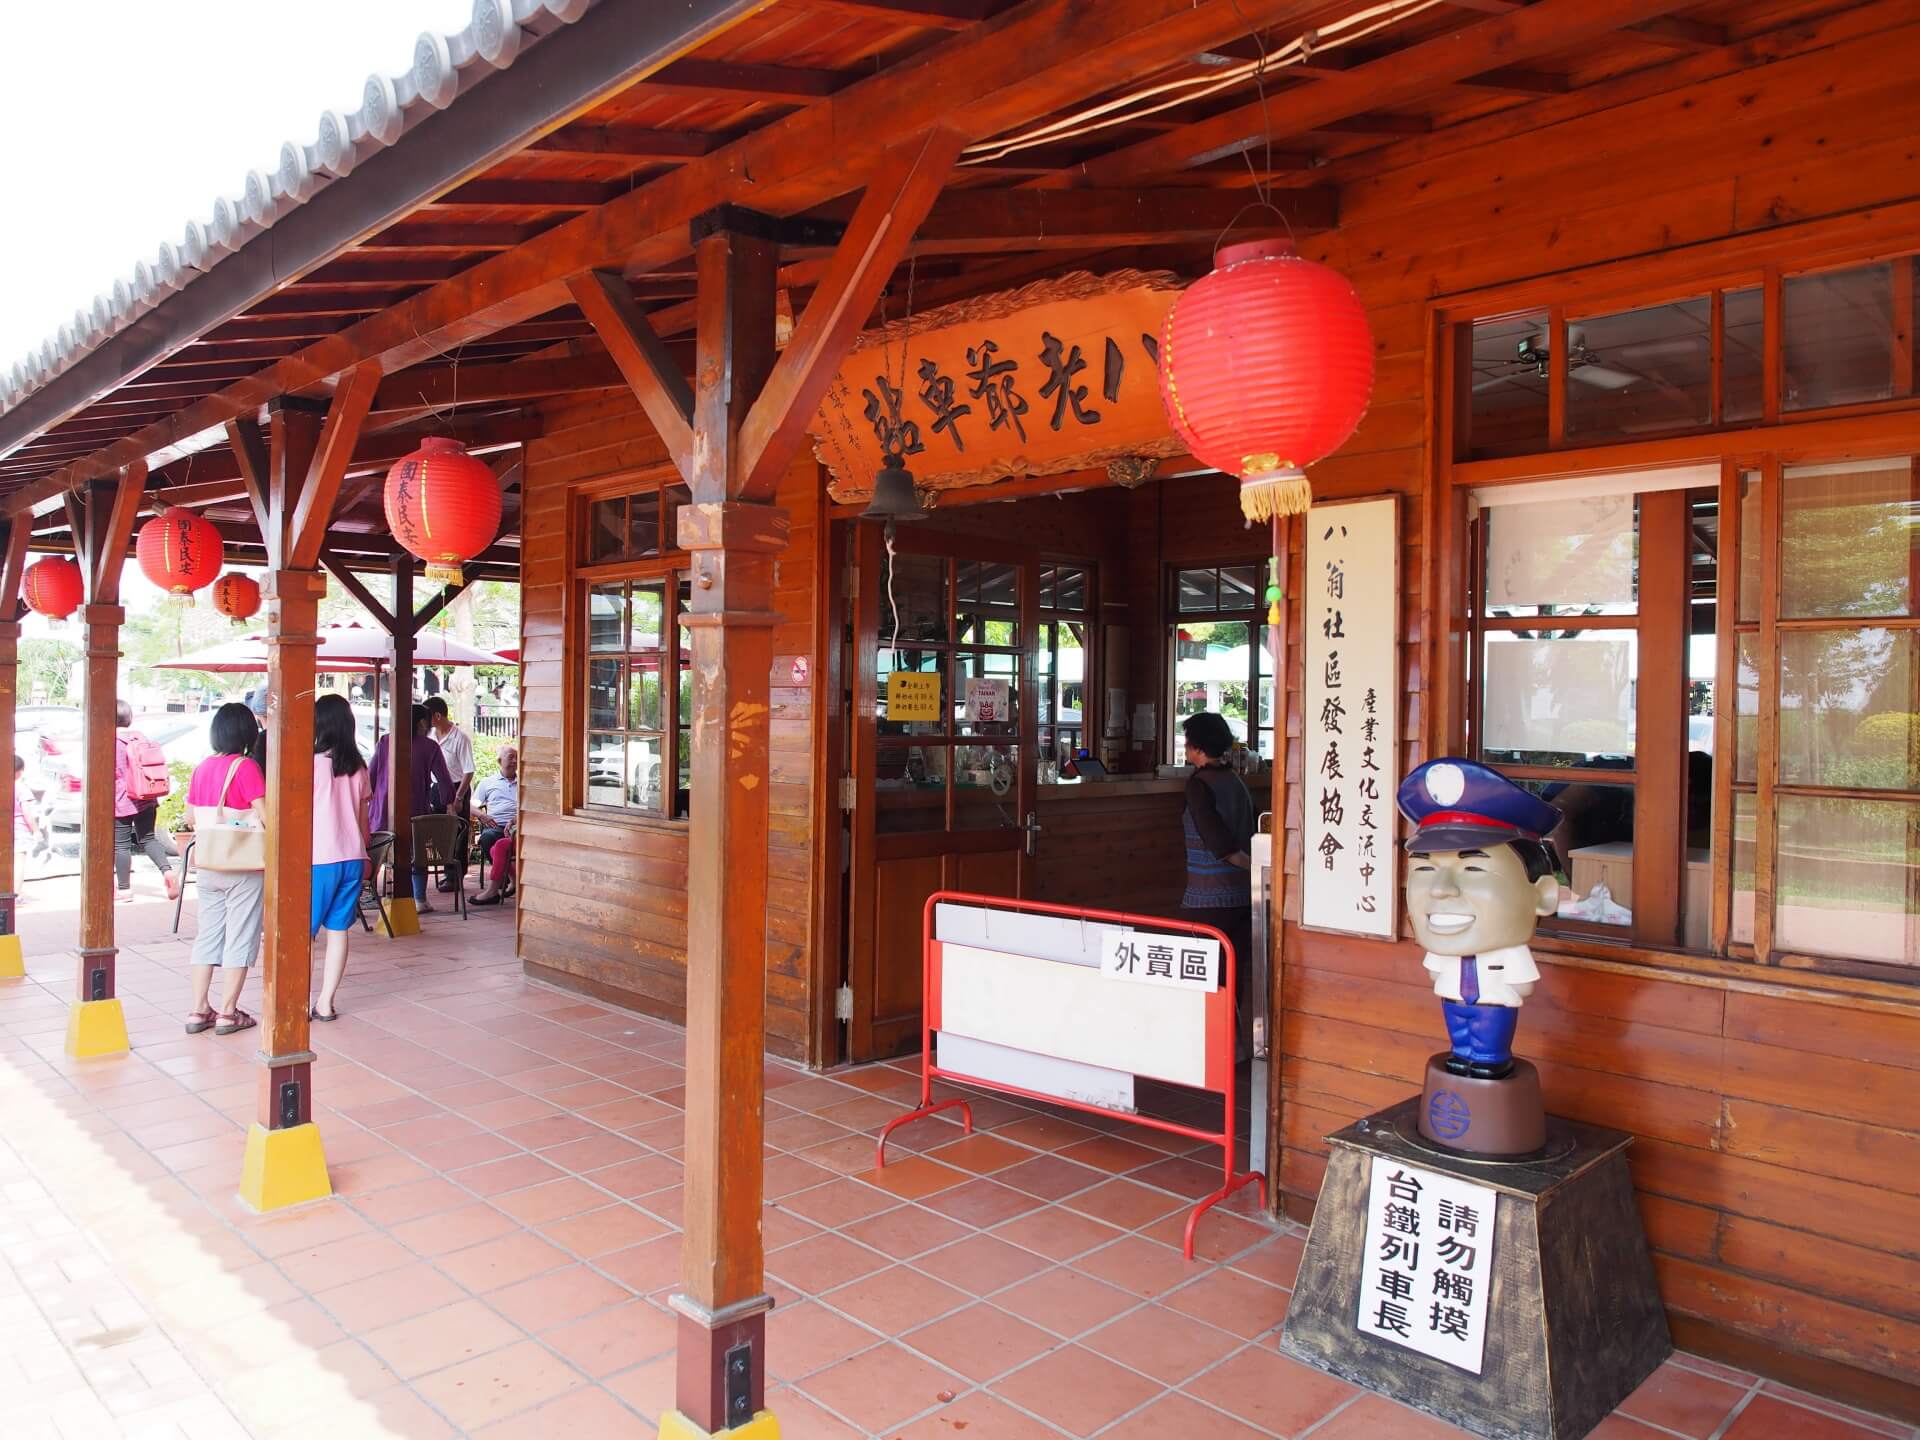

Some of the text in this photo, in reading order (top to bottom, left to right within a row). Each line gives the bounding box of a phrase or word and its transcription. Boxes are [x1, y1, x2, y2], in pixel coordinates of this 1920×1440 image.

[177, 519, 194, 575] 國泰民安
[1318, 525, 1347, 872] 八翁社區發展協會
[1355, 688, 1381, 913] 產業文化交流中心
[1114, 942, 1208, 982] 外賣區
[1373, 1169, 1425, 1339] 台鐵列車長
[1429, 1198, 1480, 1342] 請勿觸摸
